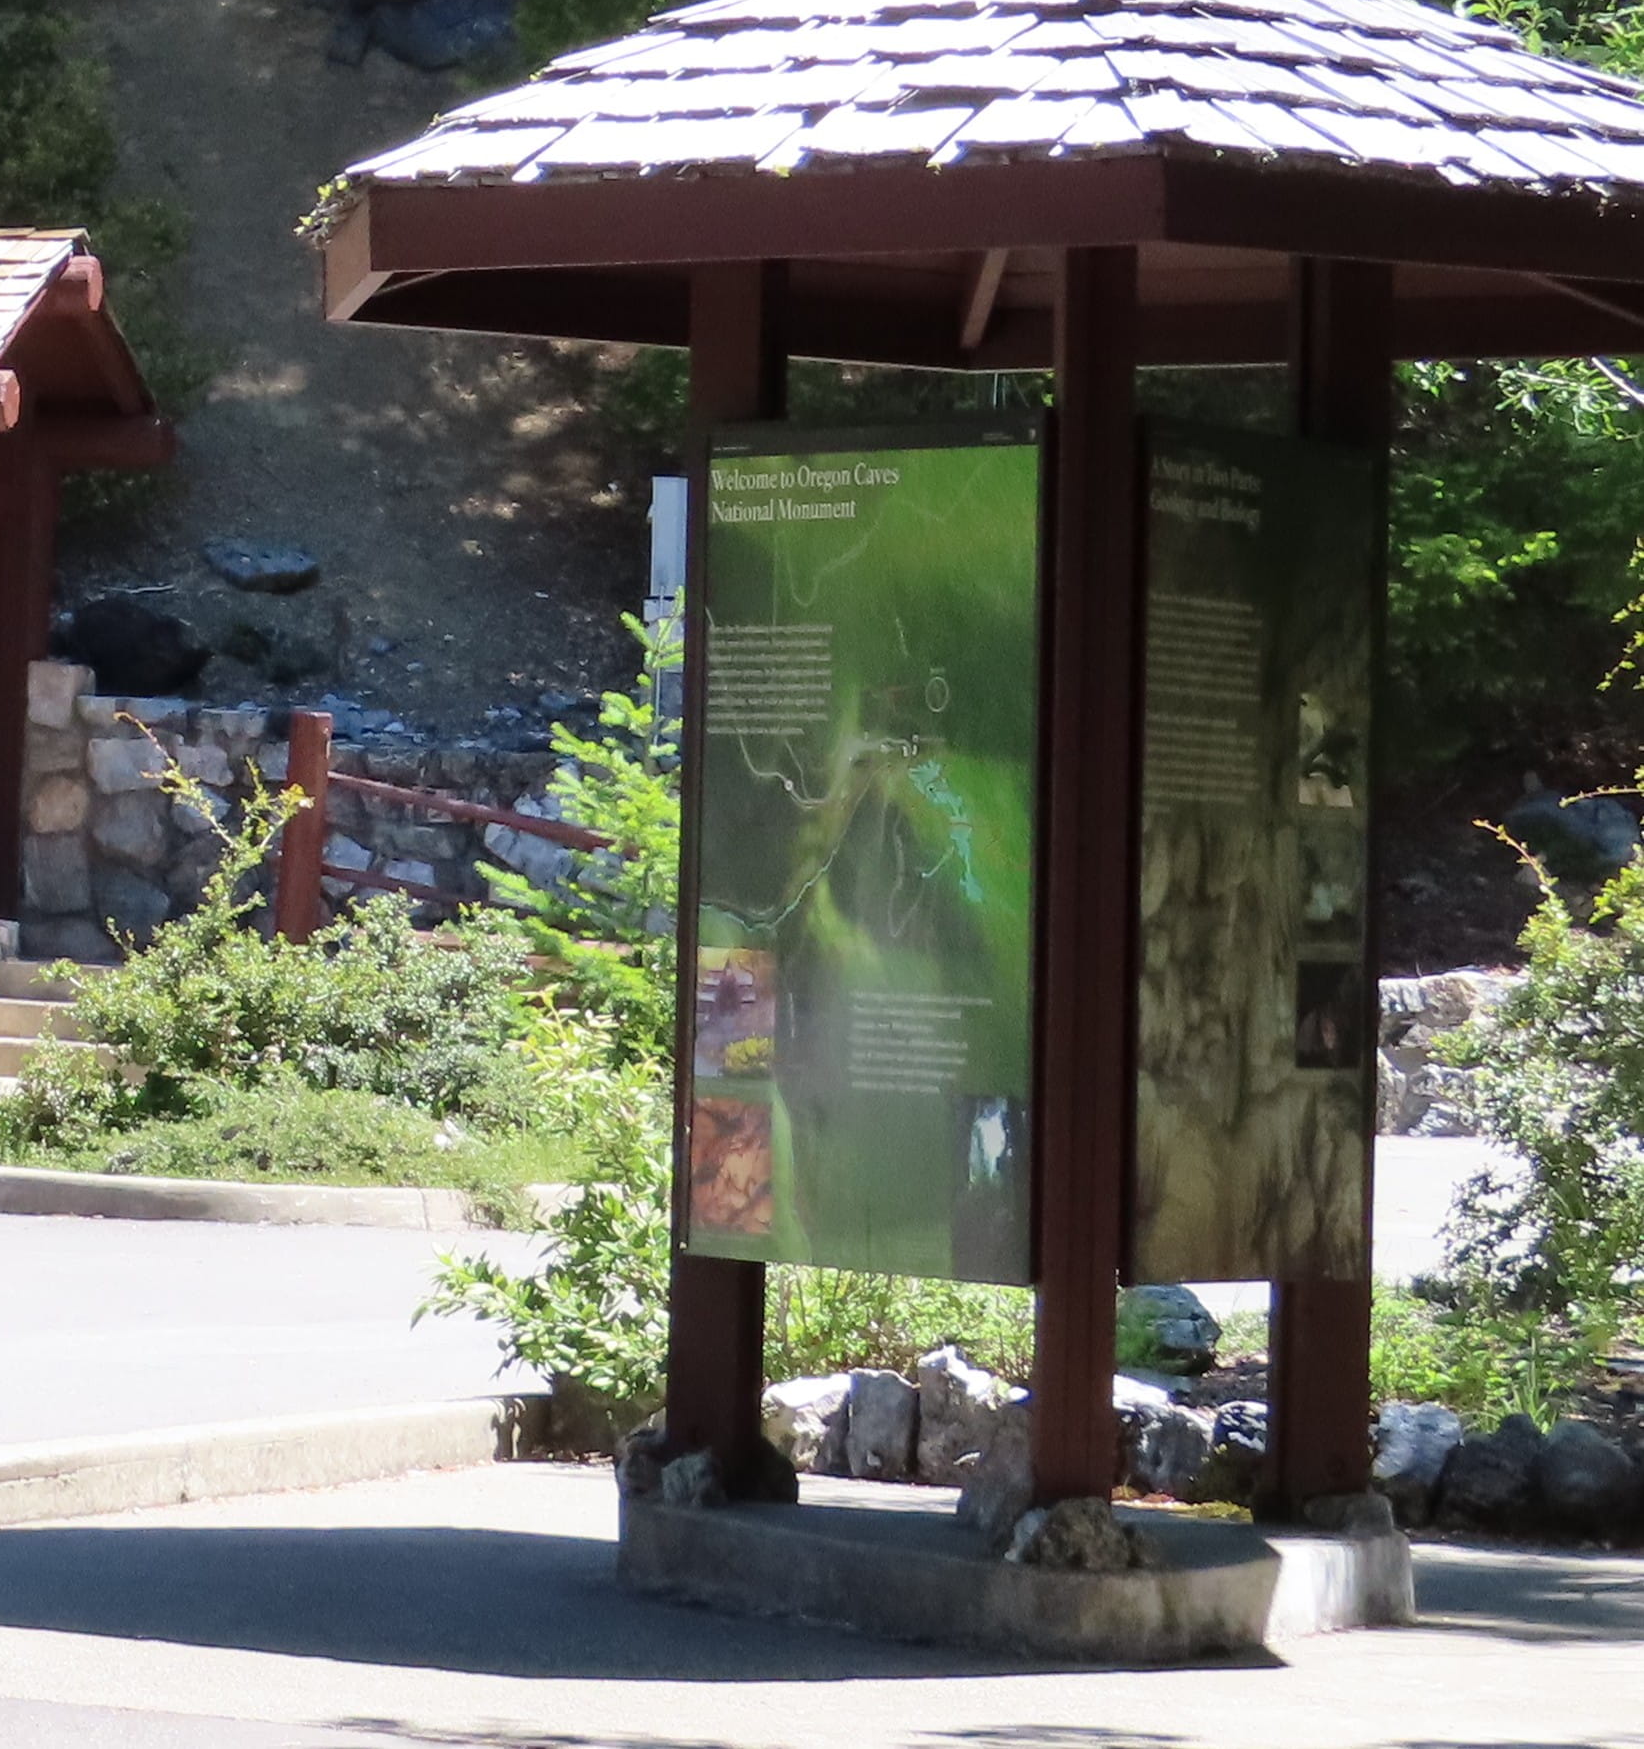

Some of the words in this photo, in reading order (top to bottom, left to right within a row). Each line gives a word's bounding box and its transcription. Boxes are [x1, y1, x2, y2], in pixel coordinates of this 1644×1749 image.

[711, 469, 778, 491] Welcome
[780, 471, 795, 489] to
[798, 465, 850, 493] Oregon
[854, 462, 899, 485] Caves
[712, 498, 773, 523] National
[778, 499, 856, 521] Monument
